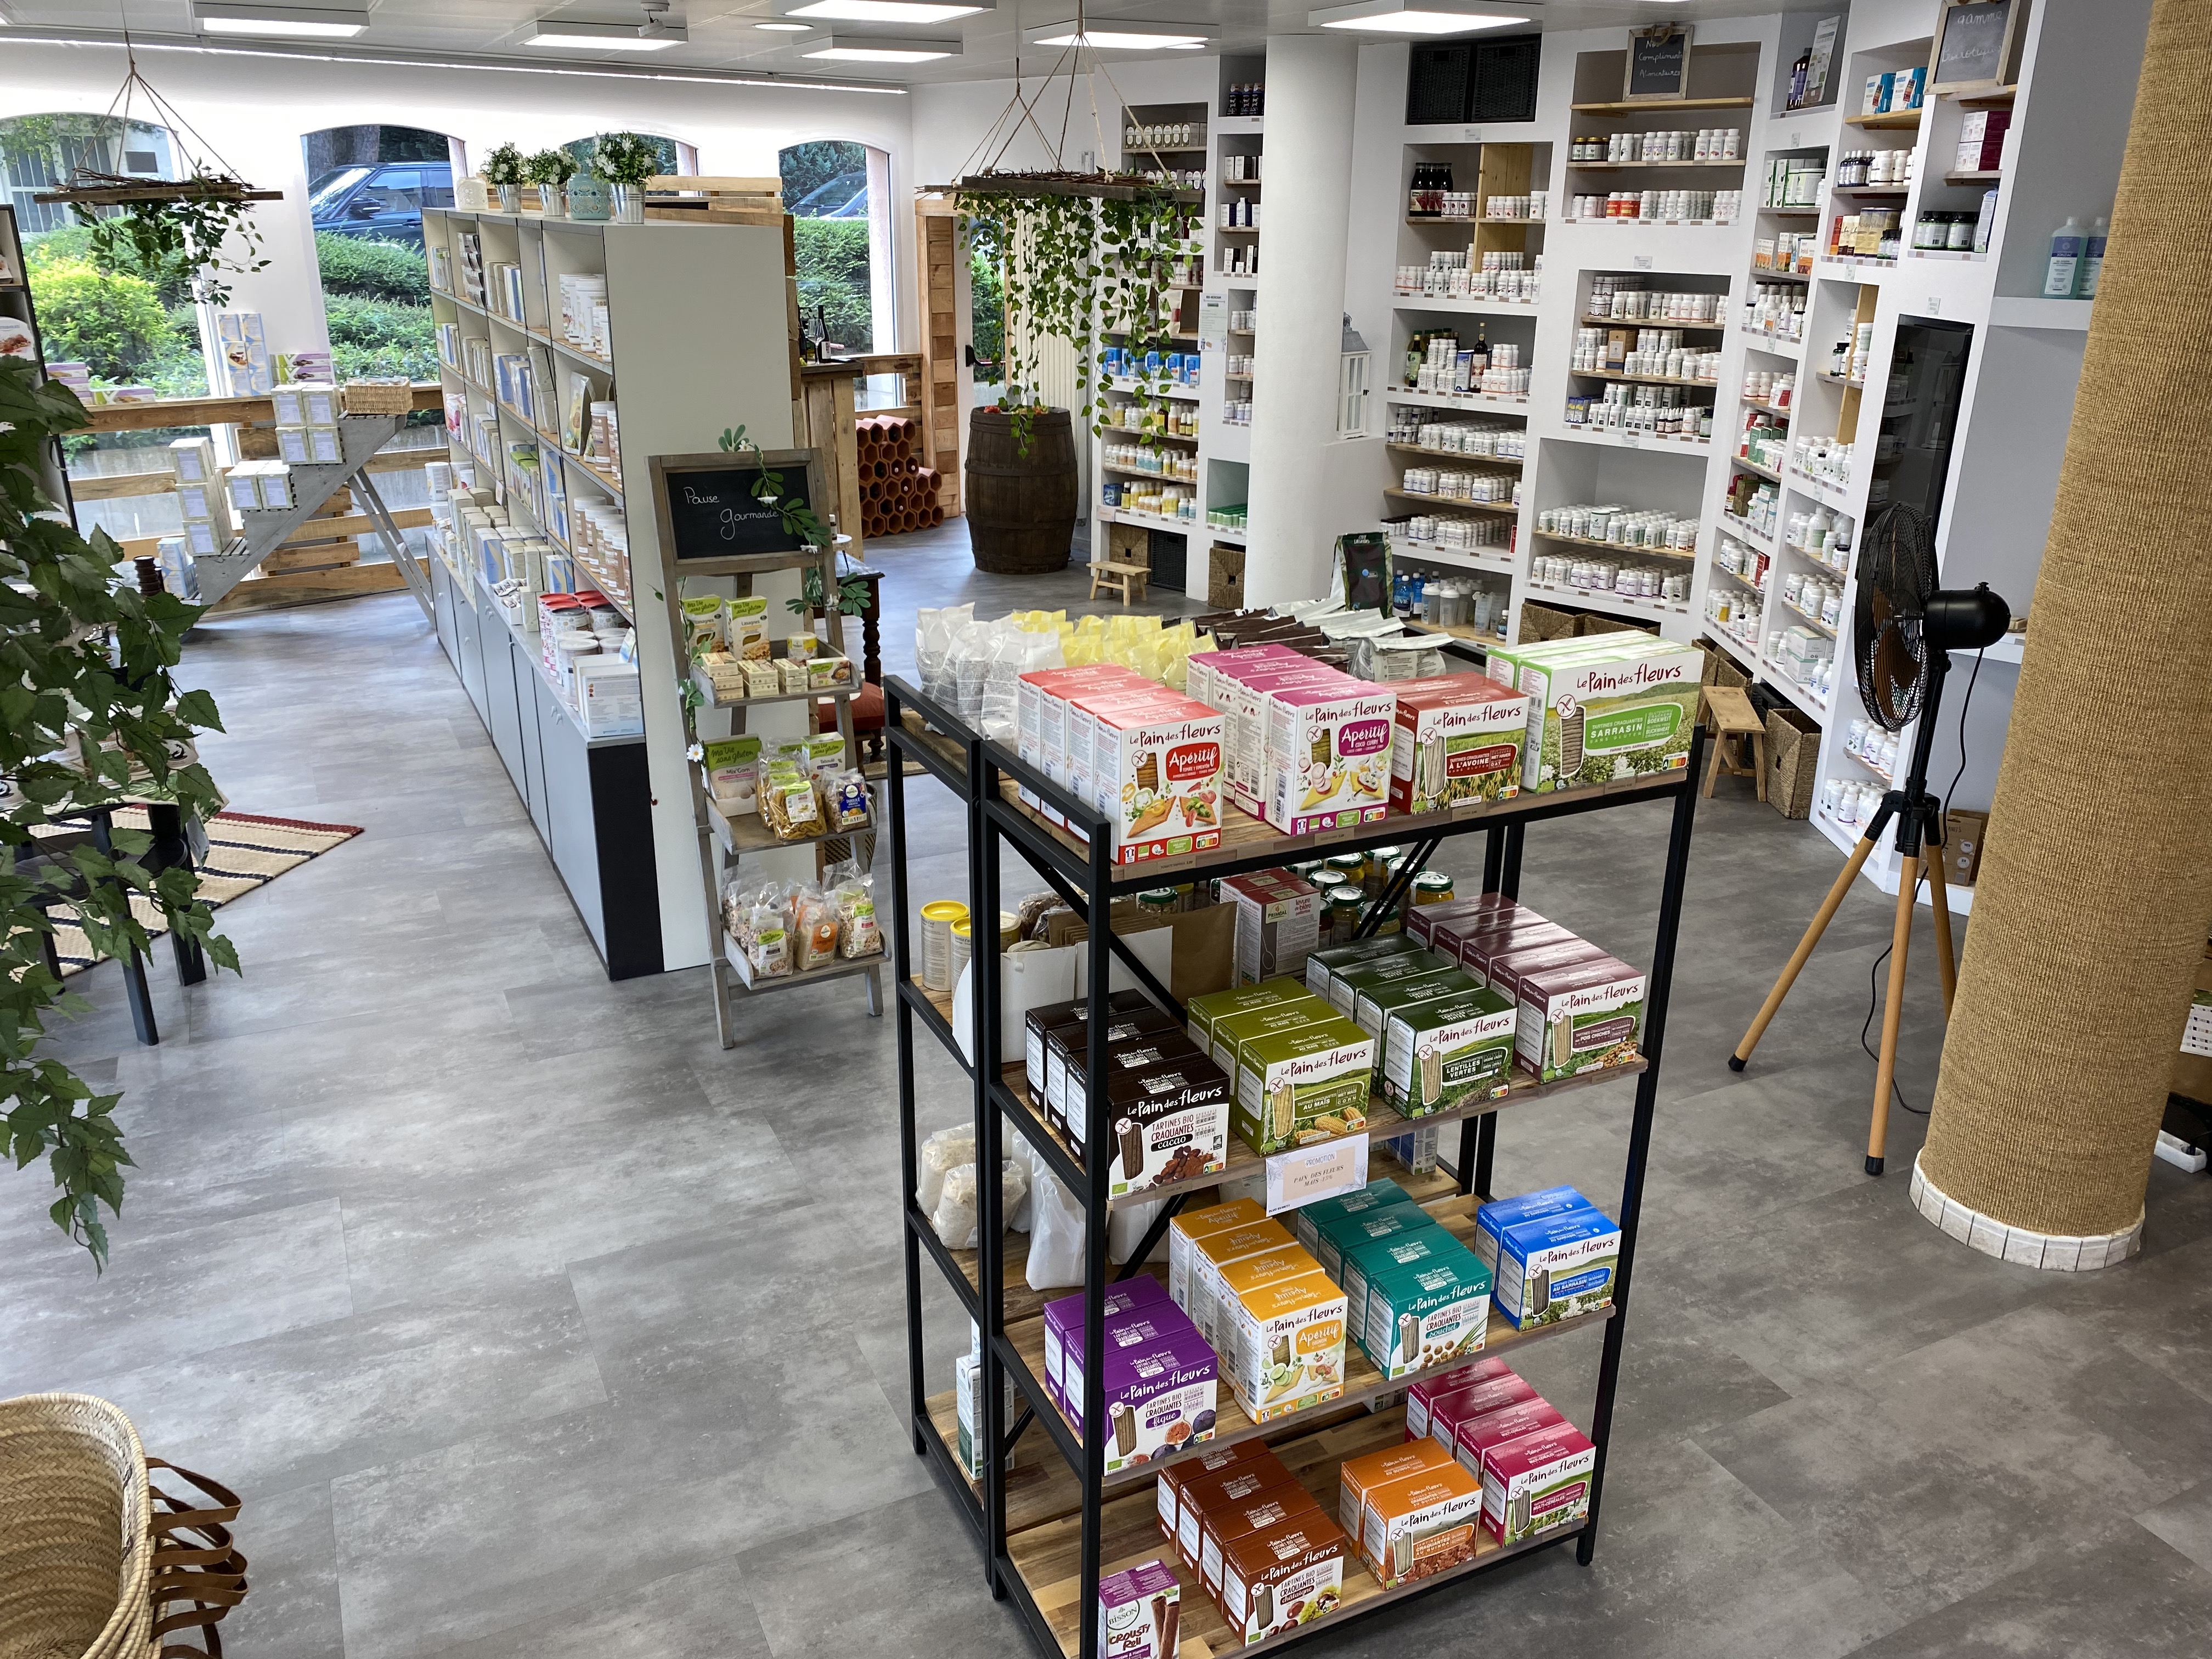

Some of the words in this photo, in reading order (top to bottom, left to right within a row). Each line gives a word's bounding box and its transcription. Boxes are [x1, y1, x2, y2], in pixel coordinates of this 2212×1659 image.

[684, 487, 719, 504] Pause
[1577, 678, 1587, 688] Le
[1589, 672, 1616, 692] Pain
[1618, 674, 1633, 685] des
[1634, 663, 1682, 685] fleurs
[1306, 712, 1314, 720] Le
[1316, 708, 1338, 723] Pain
[1339, 709, 1351, 717] des
[1352, 701, 1392, 717] fleurs
[1433, 717, 1441, 725] Le
[1443, 712, 1465, 729] Pain
[1467, 713, 1480, 723] des
[1481, 705, 1522, 722] fleurs
[1130, 736, 1138, 744] Le
[1140, 731, 1164, 747] Pain
[1165, 732, 1178, 741] des
[1179, 724, 1221, 740] fleurs
[1341, 723, 1387, 748] Apéritif
[1591, 723, 1643, 738] SARRASIN
[732, 751, 754, 762] gluten
[1169, 747, 1218, 772] Apéritif
[1456, 758, 1489, 769] L'AVOINE
[1570, 994, 1590, 1009] Pain
[1604, 984, 1639, 1000] fleurs
[1439, 1029, 1459, 1044] Pain
[1460, 1028, 1472, 1036] des
[1473, 1017, 1510, 1034] fleurs
[1291, 1062, 1313, 1077] Pain
[1314, 1060, 1327, 1069] des
[1328, 1048, 1367, 1066] fleurs
[1447, 1060, 1480, 1074] LENTILLES
[1450, 1066, 1476, 1078] VERTES
[1138, 1100, 1164, 1117] Pain
[1164, 1099, 1178, 1108] des
[1178, 1086, 1223, 1106] fleurs
[1337, 1096, 1356, 1105] CORN
[1152, 1118, 1181, 1131] TARTINES
[1183, 1114, 1194, 1125] BIO
[1151, 1123, 1194, 1142] CRAQUANTES
[1158, 1136, 1186, 1149] cacao
[1306, 1153, 1335, 1166] PROMOTION
[1323, 1165, 1344, 1175] FLEURS
[1549, 1251, 1567, 1263] Pain
[1580, 1239, 1615, 1254] fleurs
[1417, 1296, 1437, 1311] Pain
[1438, 1294, 1449, 1302] des
[1450, 1280, 1486, 1299] fleurs
[1274, 1319, 1294, 1333] Pain
[1307, 1305, 1343, 1322] fleurs
[1426, 1313, 1461, 1331] CRAQUANTES
[1427, 1309, 1451, 1323] TARTINES
[1452, 1306, 1462, 1314] BIO
[1130, 1384, 1154, 1400] Pain
[1155, 1381, 1169, 1390] des
[1169, 1365, 1211, 1386] fleurs
[1146, 1397, 1171, 1410] TARTINES
[1172, 1393, 1182, 1402] BIO
[1146, 1400, 1182, 1419] CRAQUANTES
[1152, 1412, 1177, 1426] figue
[1529, 1471, 1547, 1485] Pain
[1558, 1455, 1590, 1473] fleurs
[1410, 1514, 1429, 1527] Pain
[1442, 1497, 1477, 1515] fleurs
[1416, 1537, 1450, 1551] CRAQUANTES
[1269, 1565, 1290, 1581] Pain
[1291, 1561, 1302, 1570] des
[1302, 1544, 1339, 1565] fleurs
[1280, 1577, 1315, 1597] CRAQUANTES
[1281, 1575, 1305, 1589] TARTINES
[1306, 1570, 1314, 1578] BIO
